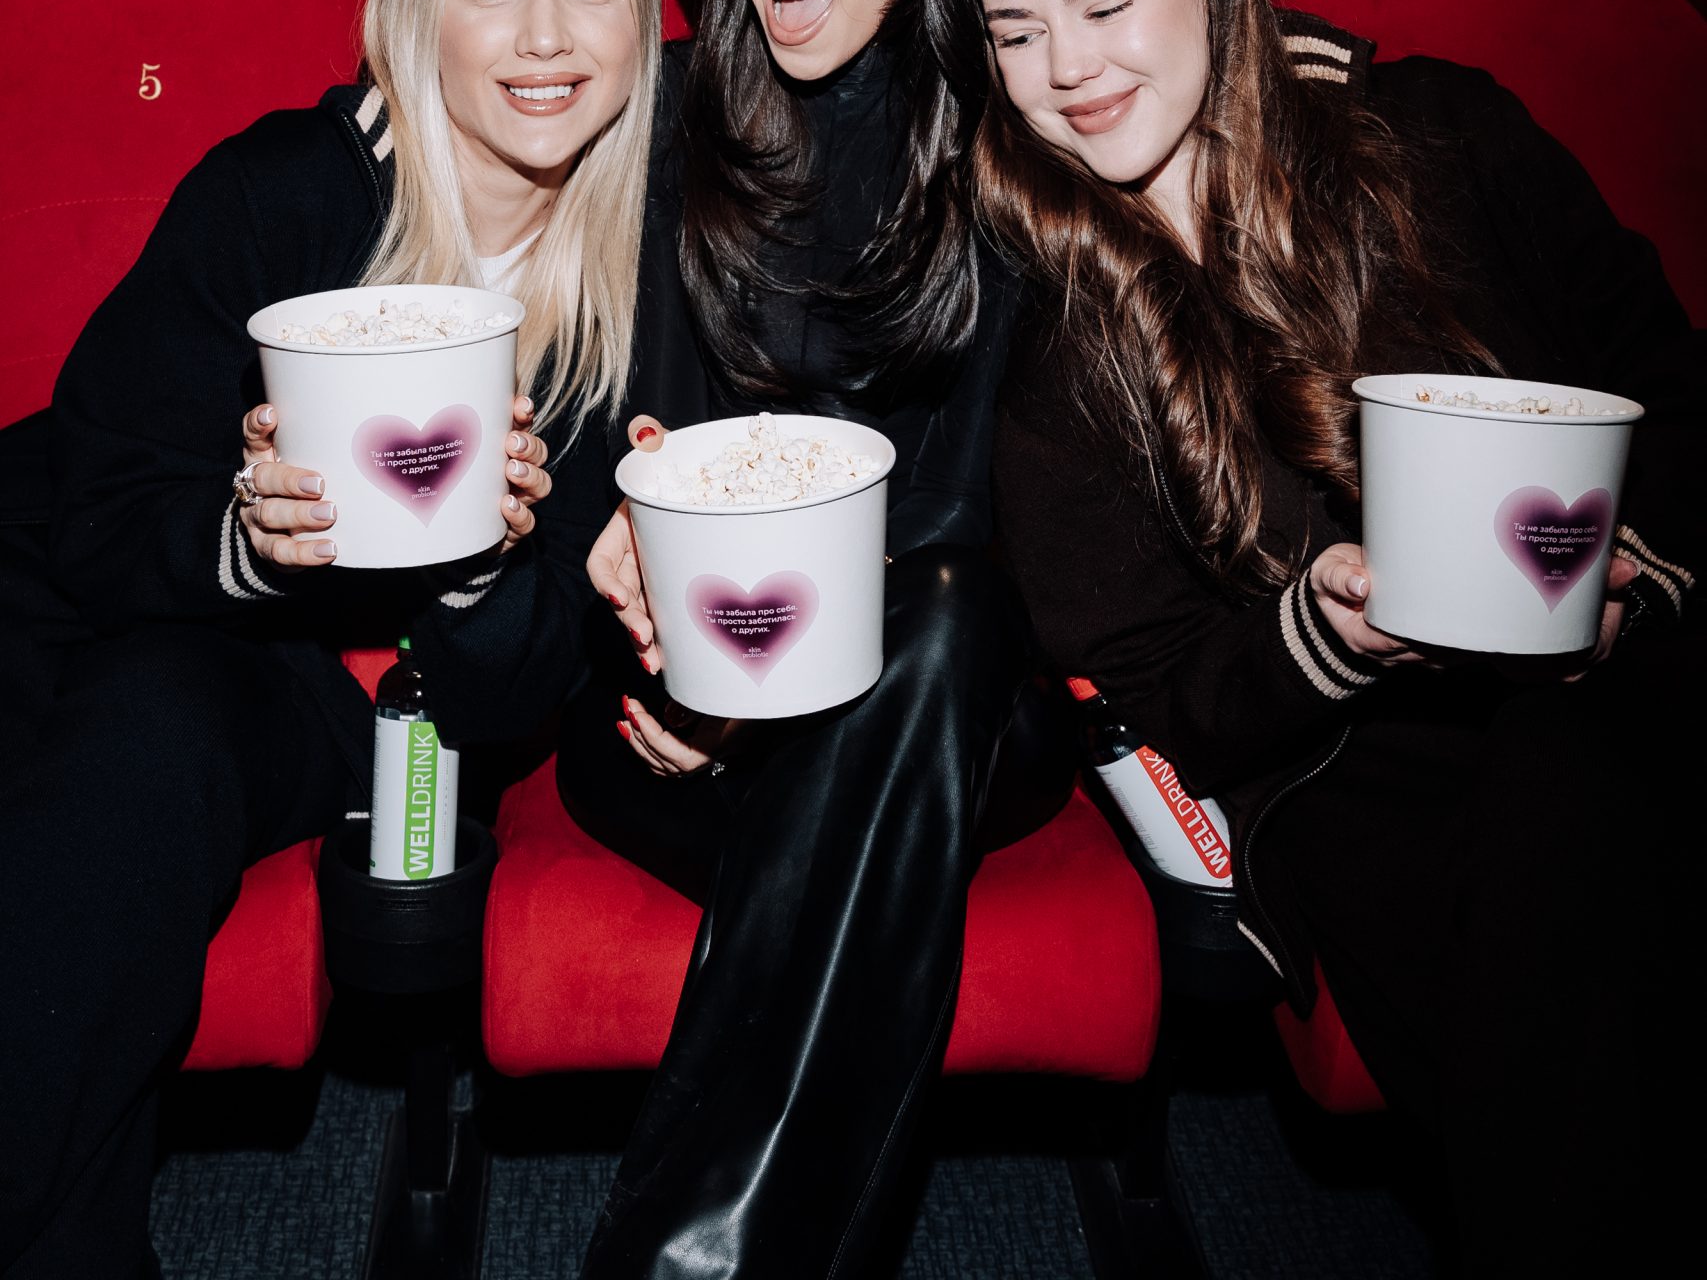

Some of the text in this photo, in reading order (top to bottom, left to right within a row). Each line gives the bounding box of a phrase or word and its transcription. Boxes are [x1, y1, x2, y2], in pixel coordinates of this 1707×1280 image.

[138, 63, 162, 100] 5
[384, 450, 394, 458] не
[396, 447, 427, 457] забыла
[429, 444, 444, 454] про
[445, 439, 465, 449] себя.
[387, 458, 417, 468] просто
[418, 449, 463, 464] заботилась
[409, 464, 440, 475] других.
[1514, 523, 1525, 531] Ты
[1540, 526, 1568, 534] забыла
[1570, 527, 1584, 535] про
[1515, 533, 1527, 541] Ты
[1529, 535, 1557, 543] просто
[1547, 546, 1575, 555] других.
[702, 605, 798, 617] Ты не забыла про себя.
[705, 615, 796, 626] Ты просто заботилась
[738, 626, 770, 635] других.
[409, 733, 433, 873] WELLDRINK
[1146, 754, 1229, 874] WELLDRINK
